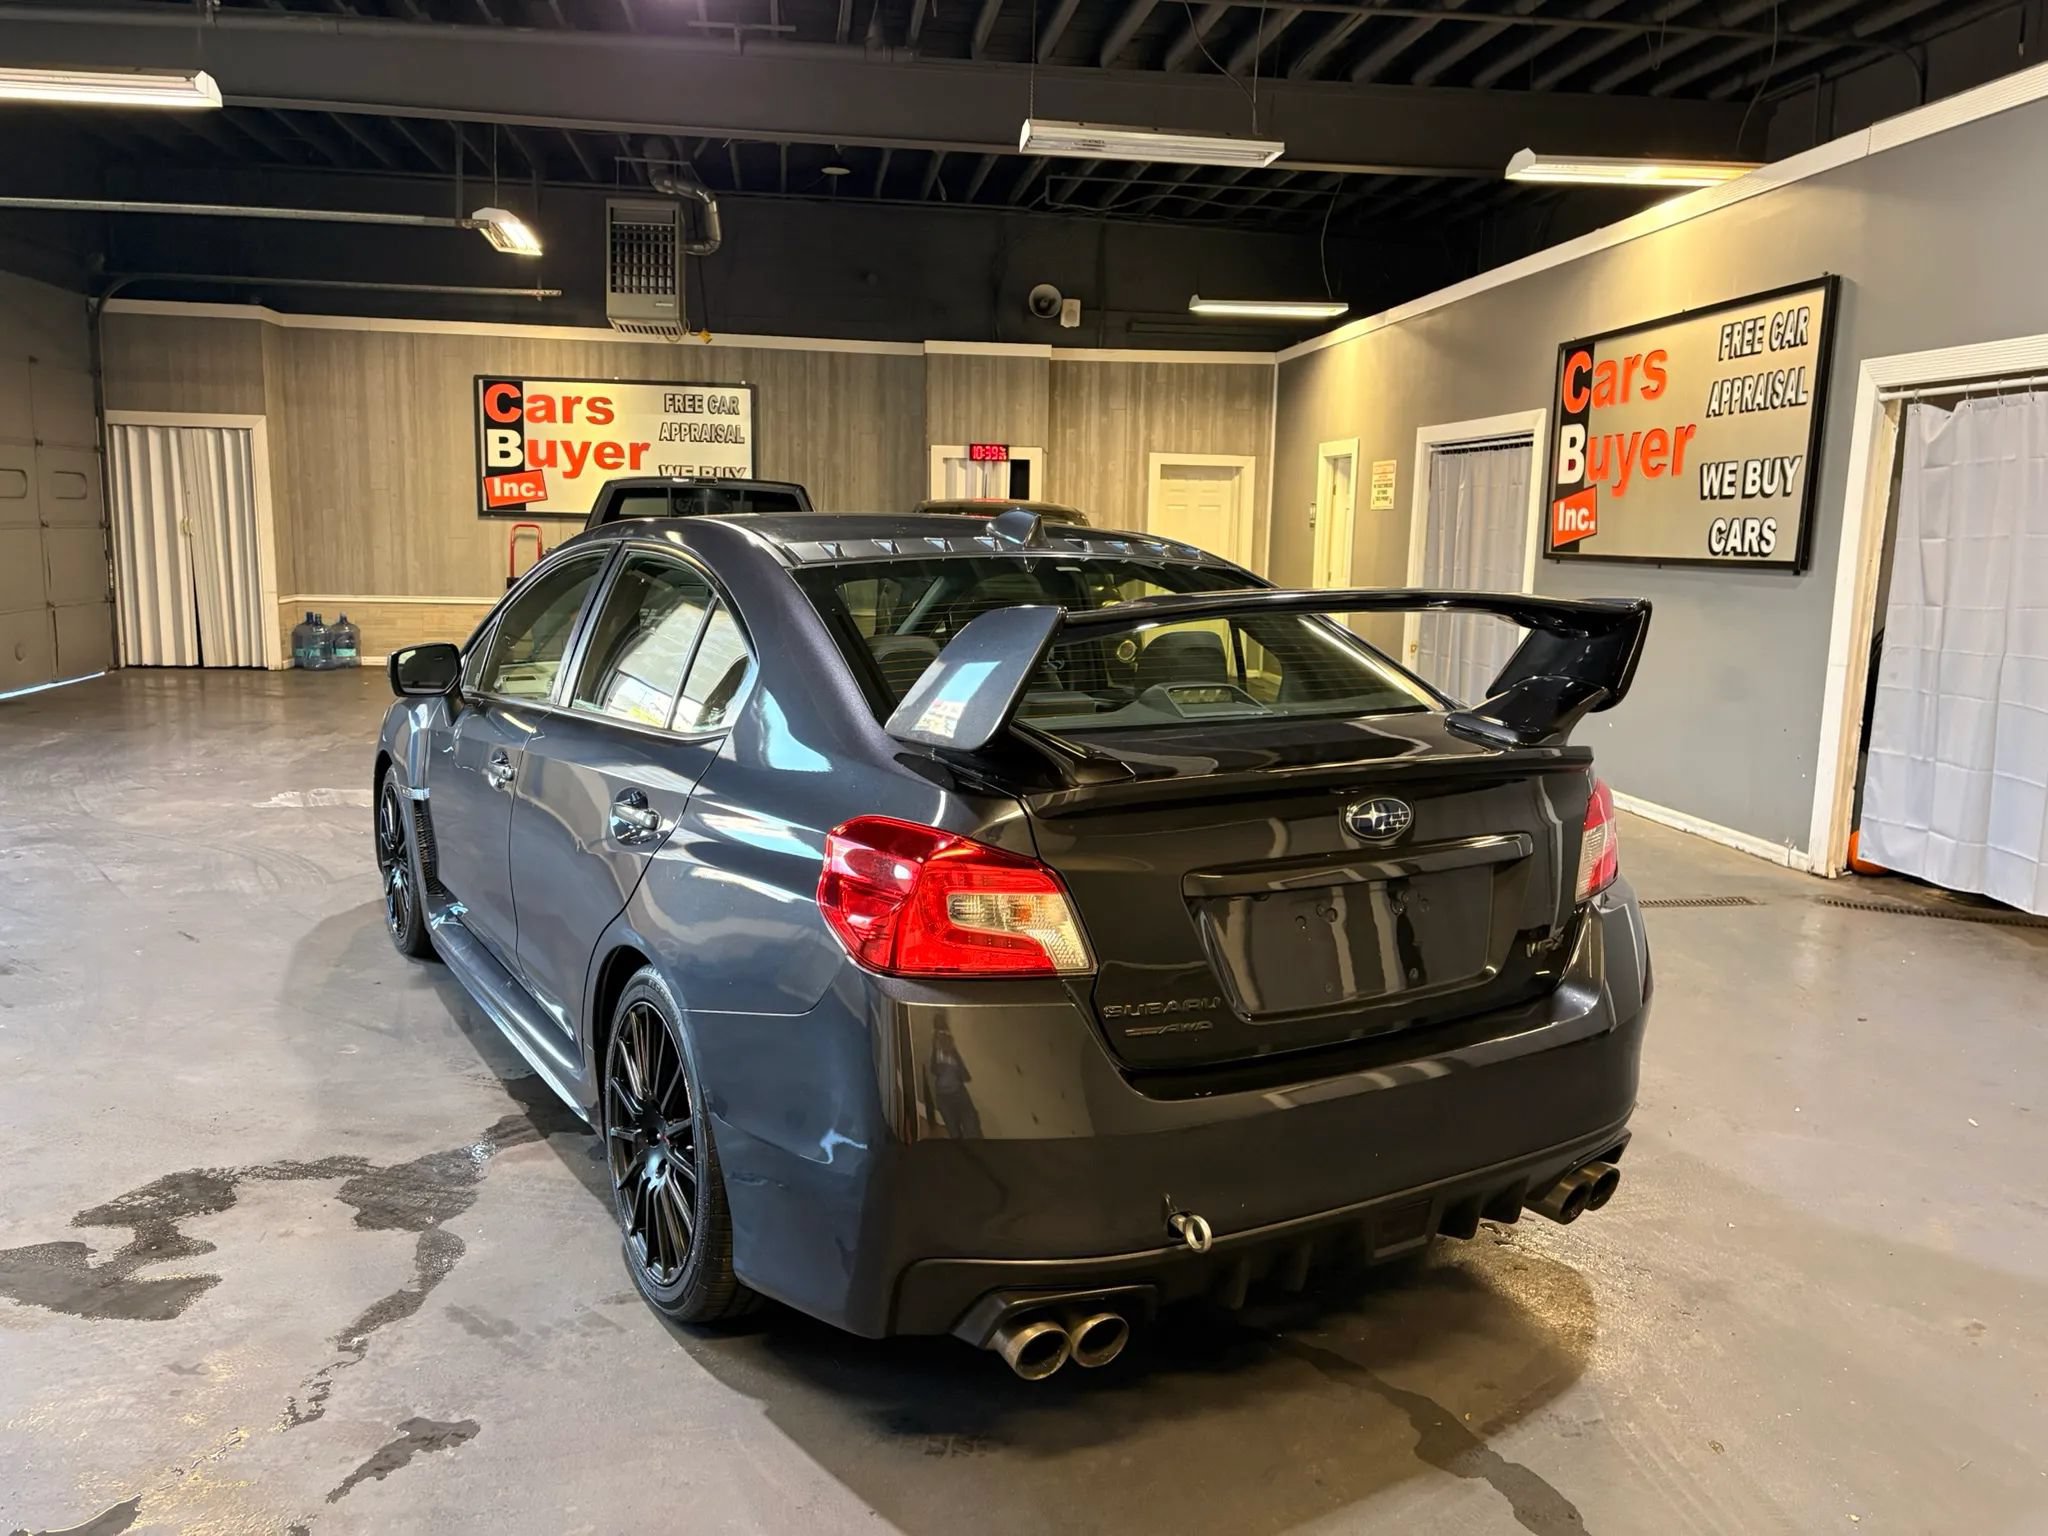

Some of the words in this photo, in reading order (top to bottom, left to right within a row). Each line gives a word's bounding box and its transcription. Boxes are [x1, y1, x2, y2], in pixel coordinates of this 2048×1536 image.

[1719, 315, 1766, 361] FREE
[1769, 306, 1811, 351] CAR
[1563, 349, 1668, 414] Cars
[1706, 366, 1808, 418] APPRAISAL
[484, 382, 615, 425] Cars
[664, 393, 704, 414] FREE
[708, 394, 740, 415] CAR
[486, 428, 651, 479] Buyer
[659, 422, 746, 444] APPRAISAL
[1557, 423, 1697, 498] Buyer
[1700, 460, 1738, 500] WE
[1742, 455, 1803, 499] BUY
[493, 478, 545, 498] Inc.
[1558, 501, 1595, 531] Inc.
[1708, 517, 1777, 557] CARS
[1103, 996, 1221, 1019] SUBARU
